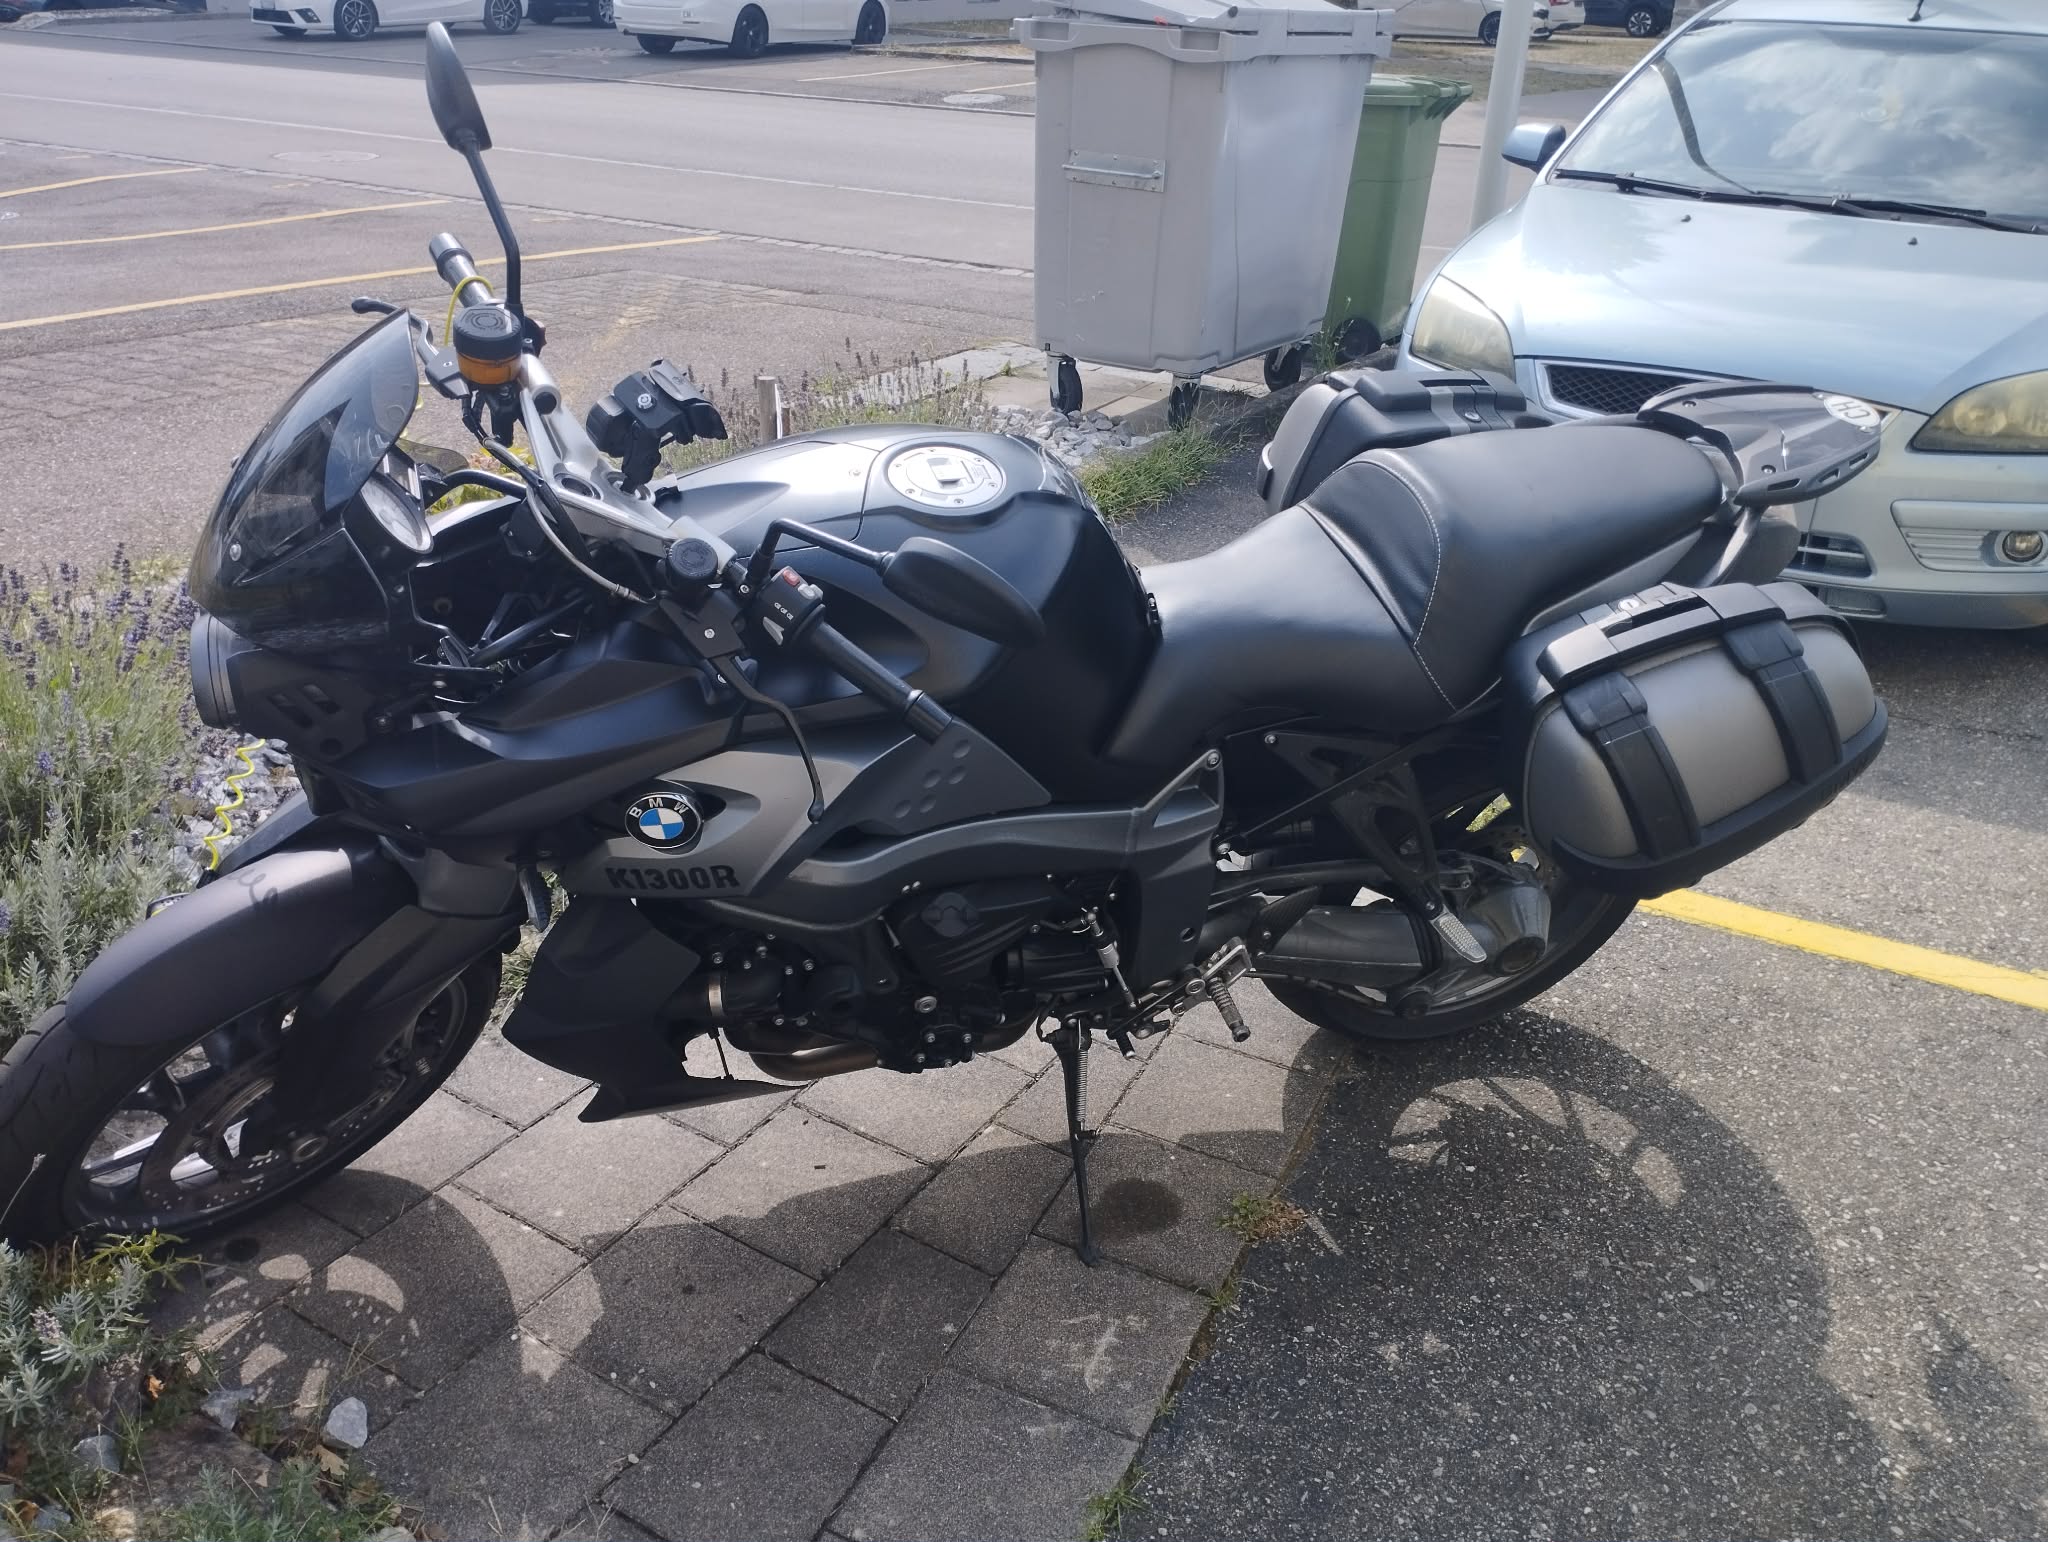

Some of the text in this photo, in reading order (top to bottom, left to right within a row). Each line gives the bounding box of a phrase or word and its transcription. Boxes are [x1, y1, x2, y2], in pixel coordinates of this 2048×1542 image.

[1832, 401, 1871, 419] CH
[628, 797, 689, 819] BMW
[604, 865, 741, 889] K1300R
